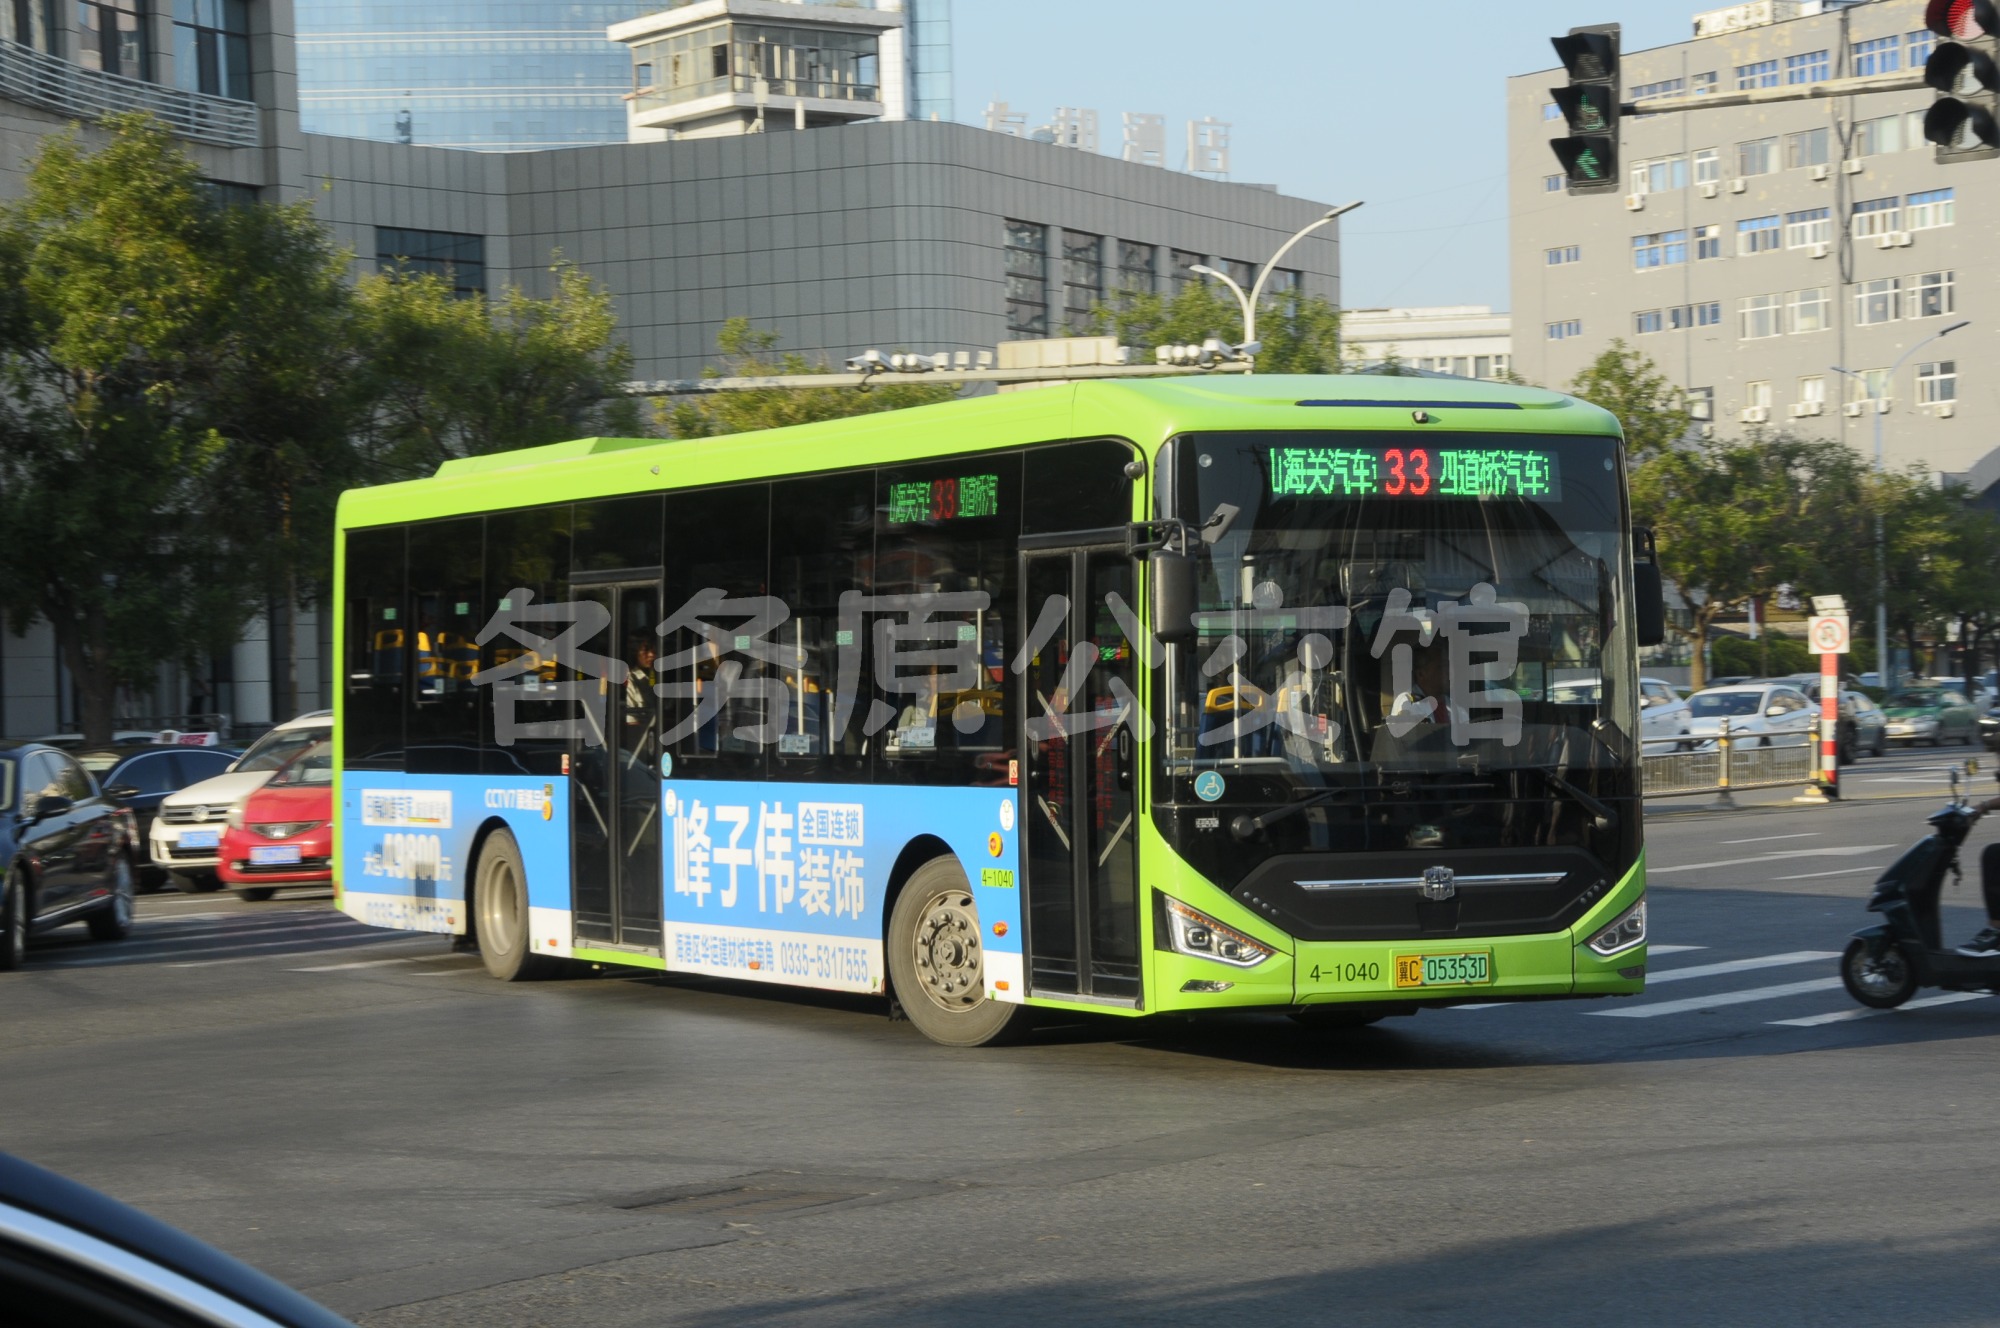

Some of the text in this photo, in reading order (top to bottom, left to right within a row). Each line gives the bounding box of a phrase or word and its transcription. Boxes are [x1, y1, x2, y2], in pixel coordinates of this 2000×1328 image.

[1385, 449, 1430, 495] 33
[932, 477, 955, 520] 33
[802, 808, 859, 840] 全国连锁
[673, 799, 795, 914] 峰子伟
[798, 847, 864, 920] 装饰
[982, 870, 1014, 888] 4-1040
[780, 941, 868, 982] 0335-5317555
[1310, 962, 1379, 982] 4-1040
